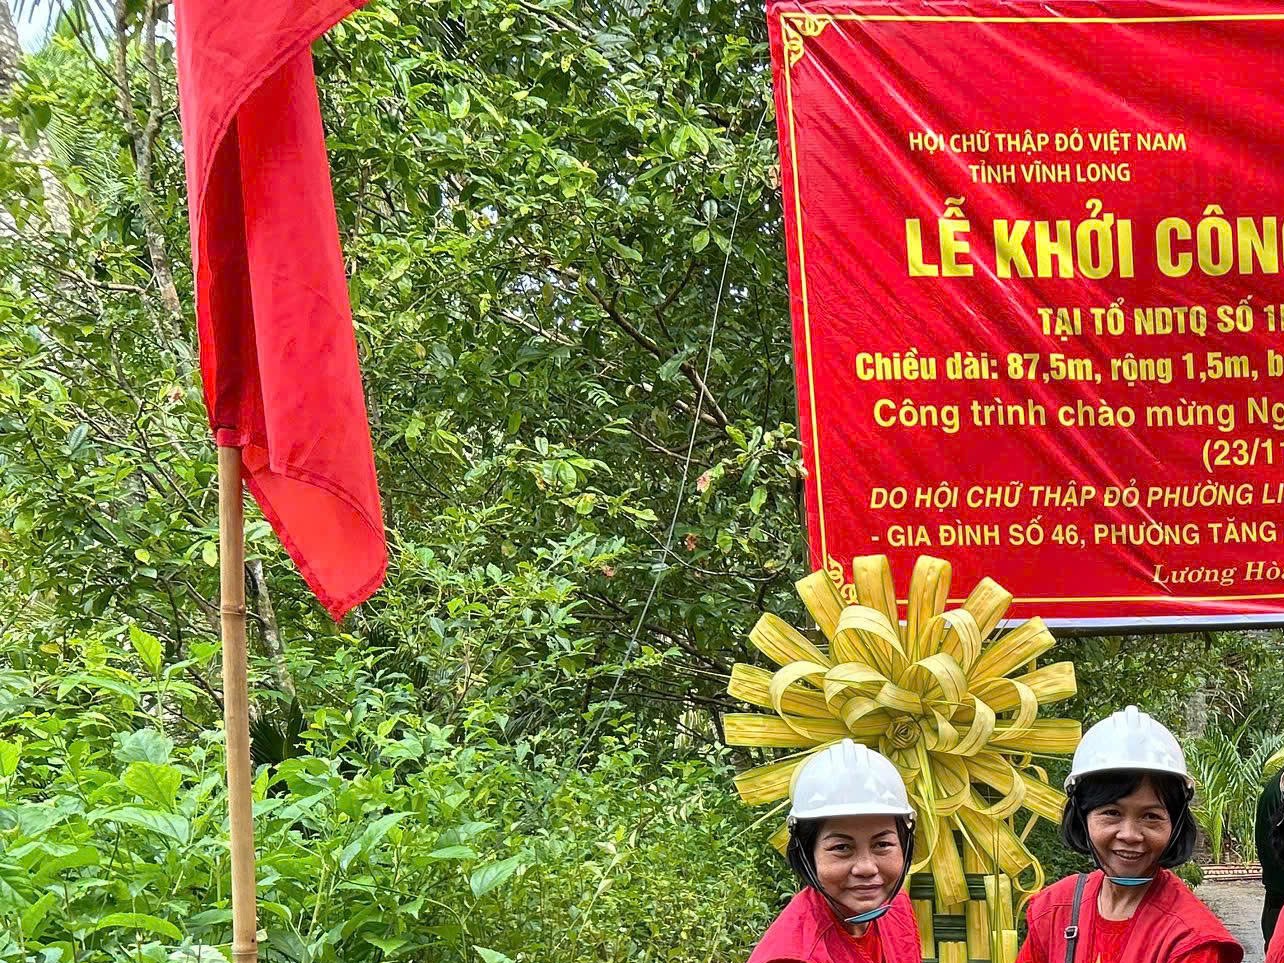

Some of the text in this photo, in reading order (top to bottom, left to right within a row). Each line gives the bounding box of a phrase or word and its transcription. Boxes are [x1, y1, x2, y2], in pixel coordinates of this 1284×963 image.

[950, 130, 991, 153] CHỮ
[995, 129, 1049, 155] THẬP
[1055, 128, 1083, 151] ĐỎ
[1088, 129, 1131, 154] VIỆT
[1137, 133, 1186, 151] NAM
[968, 160, 1130, 183] TỈNH VĨNH LONG
[906, 197, 973, 277] LỄ
[993, 199, 1134, 279] KHỞI
[1038, 308, 1082, 341] TẠI
[1090, 297, 1124, 335] TỔ
[1134, 306, 1207, 336] NDTQ
[1217, 295, 1253, 332] SỐ
[856, 348, 936, 380] Chiều
[946, 352, 998, 380] dài:
[1007, 353, 1101, 384] 87,5m,
[1111, 353, 1172, 386] rộng
[1182, 352, 1258, 382] 1,5m,
[874, 399, 959, 433] Công
[971, 398, 1045, 426] trình
[1058, 399, 1135, 427] chào
[1147, 398, 1234, 432] mừng
[870, 487, 907, 508] DO
[915, 481, 958, 512] HỘI
[967, 481, 1023, 508] CHỮ
[1029, 480, 1096, 511] THẬP
[1104, 479, 1136, 506] ĐỎ
[1147, 480, 1253, 507] PHƯỜNG
[888, 525, 931, 546] GIA
[939, 520, 999, 545] ĐÌNH
[1009, 515, 1043, 545] SỐ
[1052, 525, 1085, 548] 46,
[1208, 518, 1276, 543] TĂNG
[1151, 565, 1237, 586] Lương
